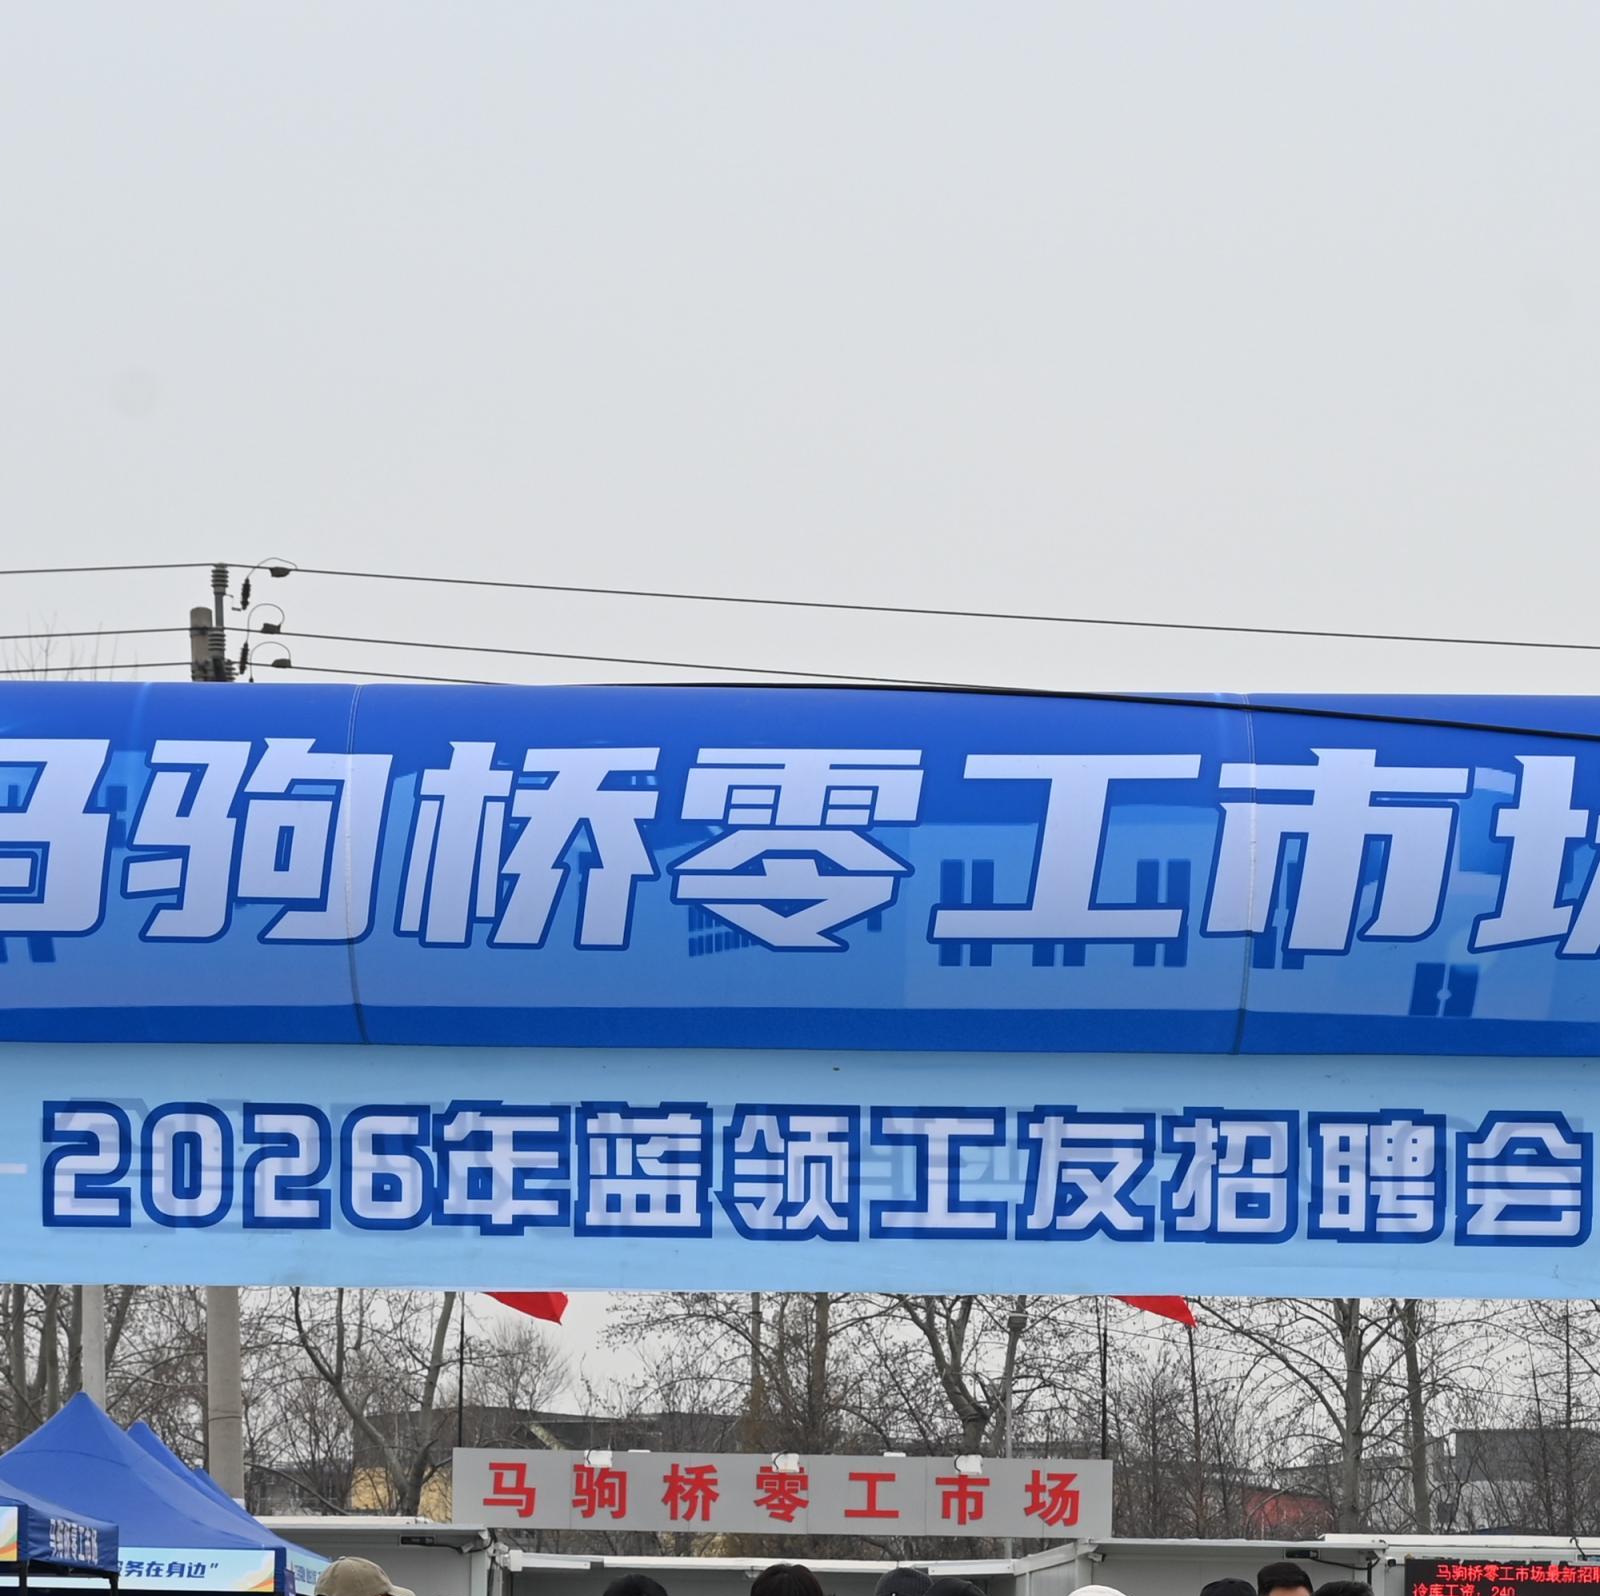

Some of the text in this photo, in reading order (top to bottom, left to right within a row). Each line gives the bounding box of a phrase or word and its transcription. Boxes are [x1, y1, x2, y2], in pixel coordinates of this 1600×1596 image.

[44, 1101, 1594, 1245] 2026年蓝领工友招聘会
[482, 1461, 1082, 1527] 马驹桥零工市场
